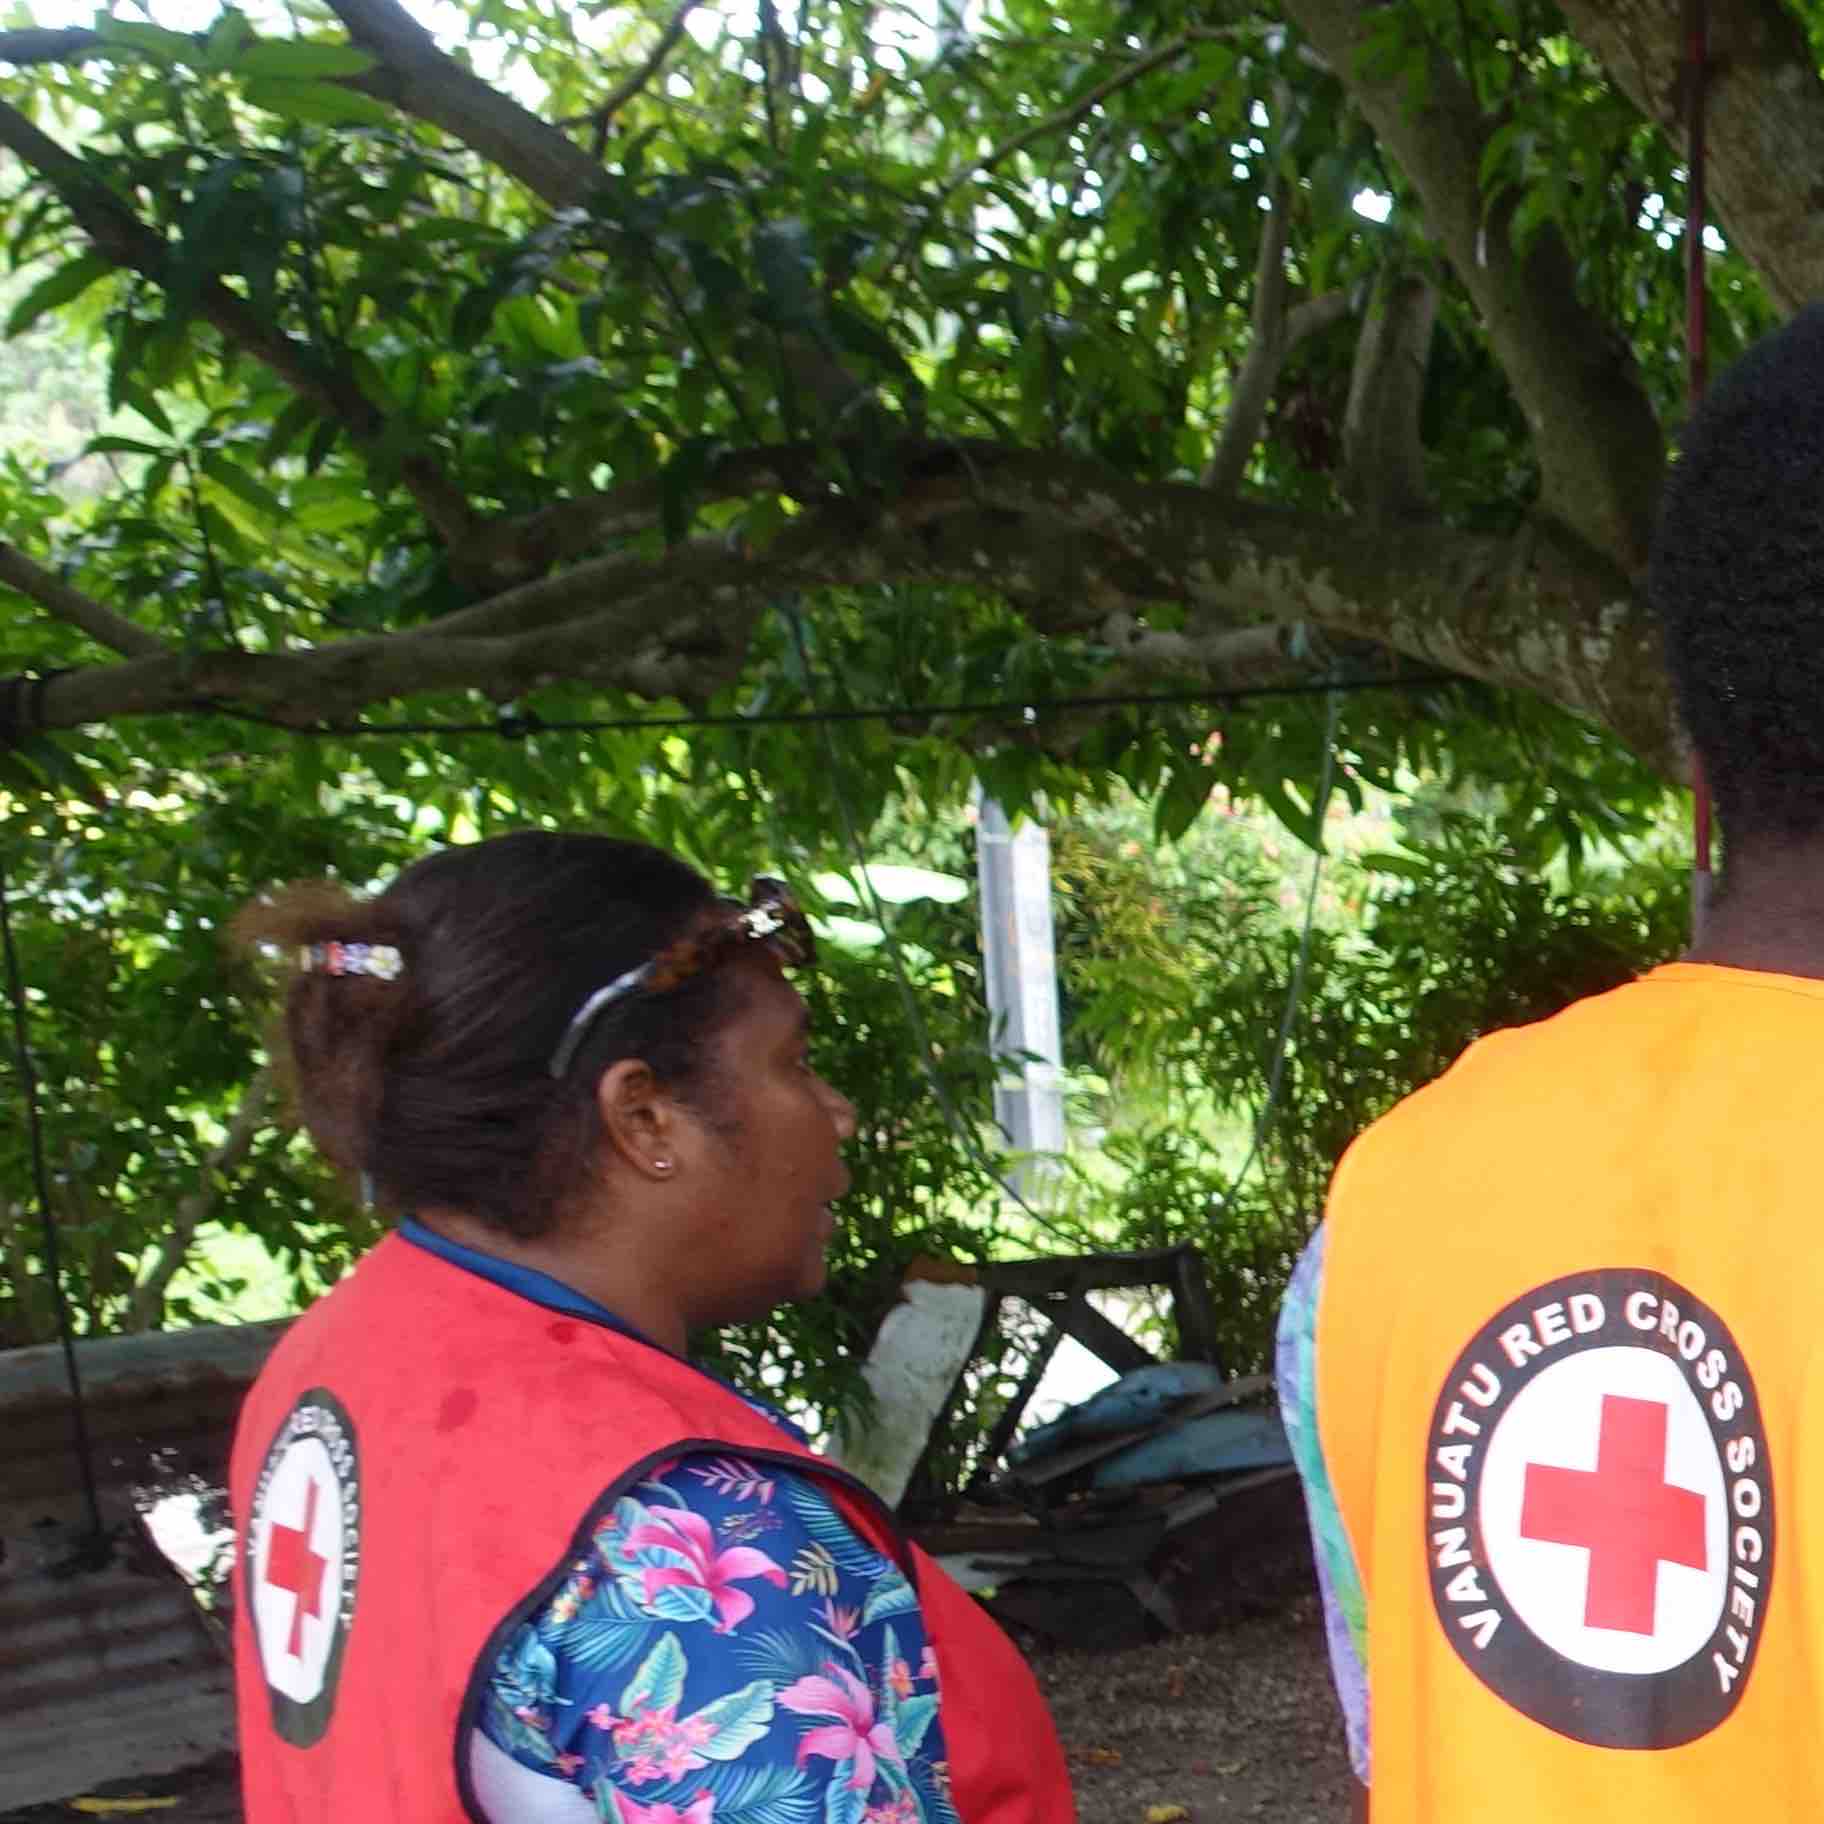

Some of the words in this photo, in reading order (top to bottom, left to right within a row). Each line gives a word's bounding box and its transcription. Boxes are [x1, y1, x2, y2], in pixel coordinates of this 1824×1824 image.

[1431, 1363, 1501, 1648] VANUATU
[1499, 1292, 1606, 1367] RED
[1625, 1291, 1744, 1421] CROSS
[1712, 1435, 1763, 1693] SOCIETY
